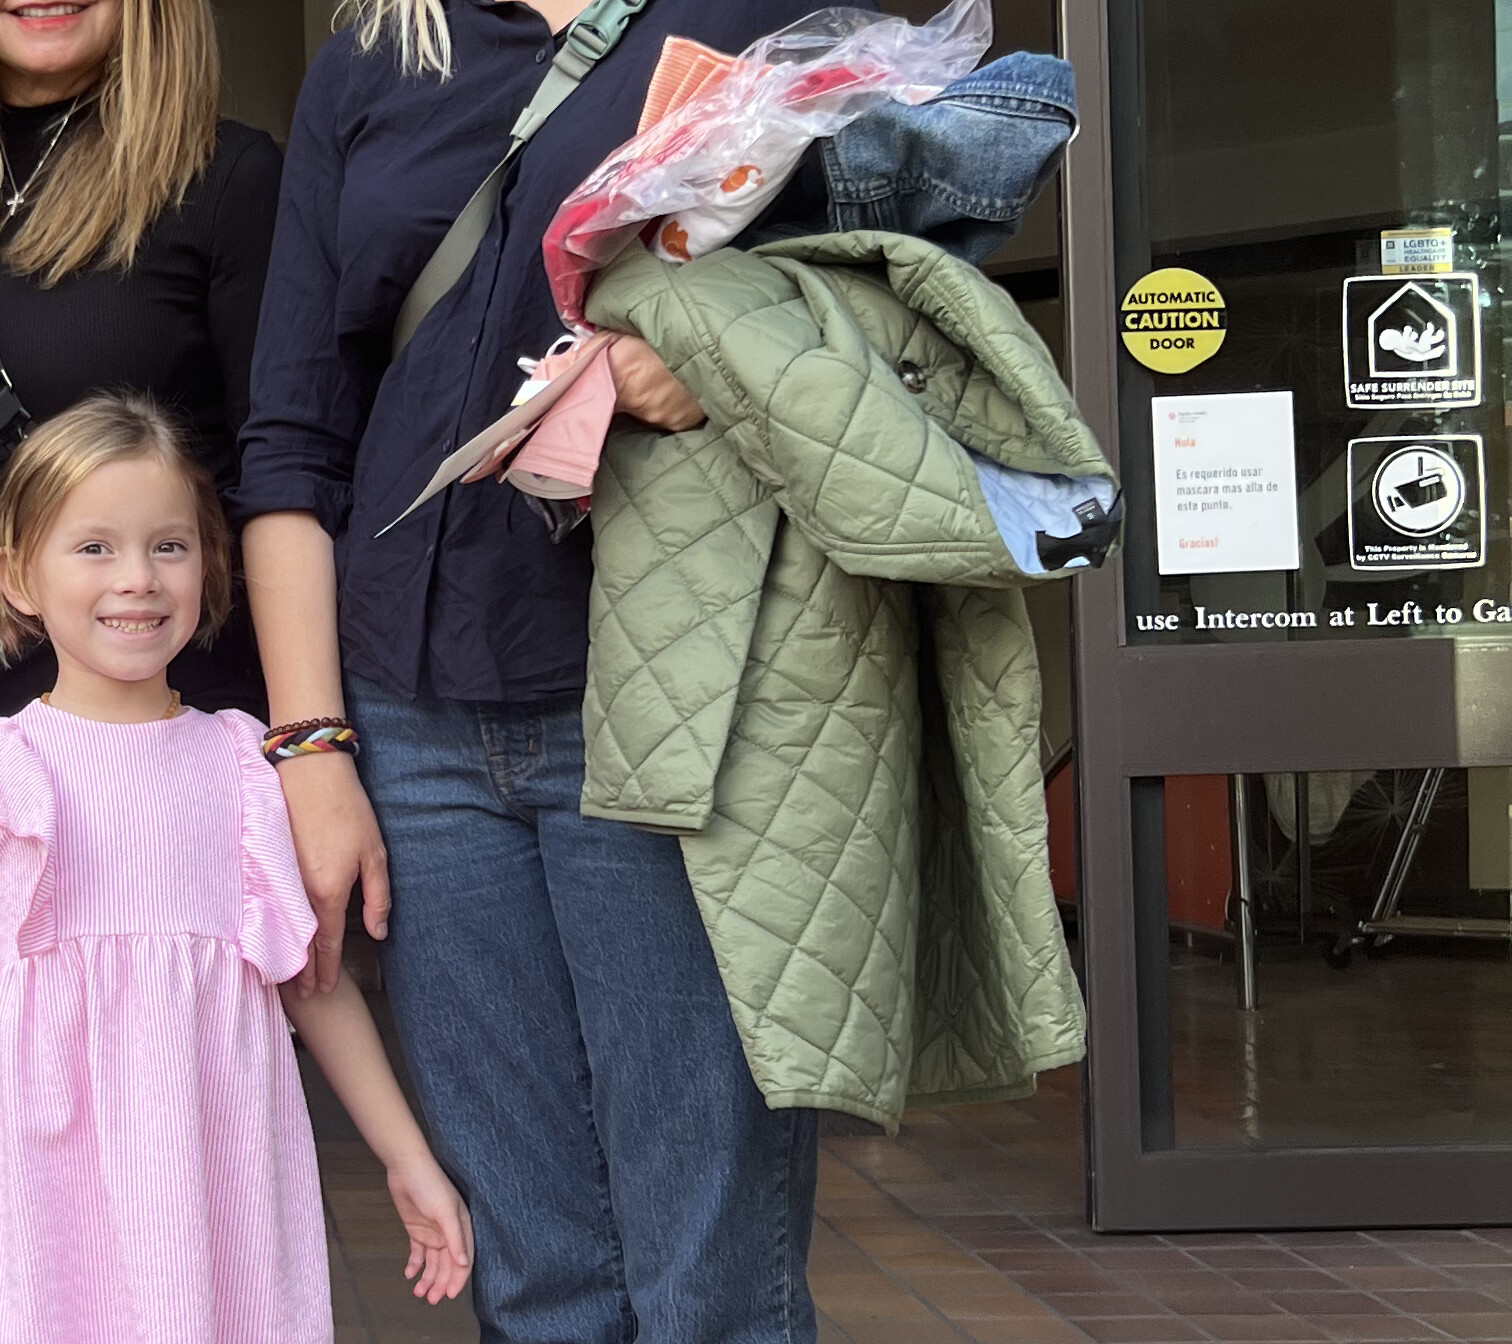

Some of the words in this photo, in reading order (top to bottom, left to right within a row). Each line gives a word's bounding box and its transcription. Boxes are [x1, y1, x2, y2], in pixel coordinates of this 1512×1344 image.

[1404, 254, 1447, 263] EQUALITY
[1400, 264, 1435, 272] LEADER
[1128, 290, 1216, 306] AUTOMATIC
[1124, 310, 1220, 330] CAUTION
[1149, 337, 1195, 350] DOOR
[1349, 382, 1379, 394] SAFE
[1380, 380, 1449, 394] SURRENDER
[1451, 379, 1475, 391] SITE
[1175, 437, 1196, 448] Hola
[1176, 469, 1187, 480] Es
[1190, 466, 1238, 481] requerido
[1240, 467, 1263, 478] usar
[1176, 485, 1219, 496] mascara
[1222, 484, 1243, 494] mas
[1245, 480, 1263, 493] alla
[1266, 480, 1279, 492] de
[1177, 500, 1198, 512] este
[1201, 499, 1232, 513] punto.
[1179, 536, 1219, 549] Gracias!
[1367, 553, 1390, 561] CCTV
[1136, 612, 1179, 632] use
[1194, 605, 1318, 631] Intercom
[1328, 606, 1355, 627] at
[1366, 601, 1423, 627] Left
[1434, 603, 1463, 625] to
